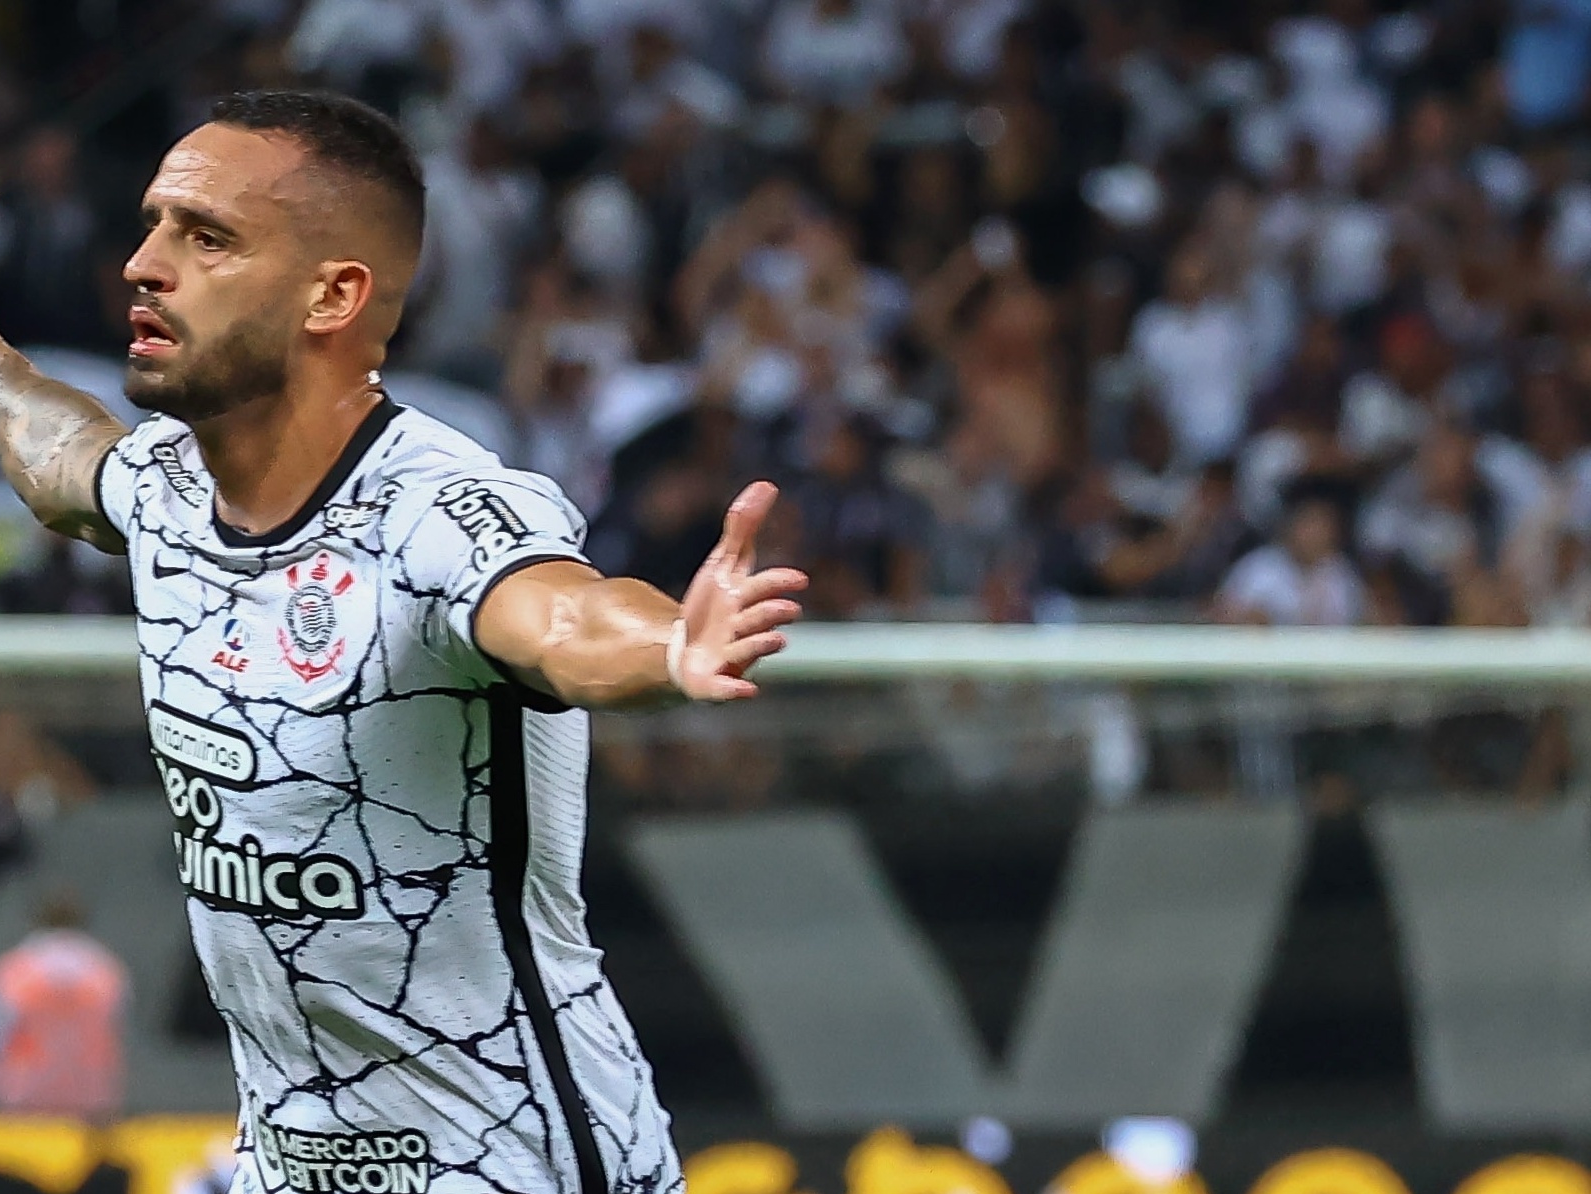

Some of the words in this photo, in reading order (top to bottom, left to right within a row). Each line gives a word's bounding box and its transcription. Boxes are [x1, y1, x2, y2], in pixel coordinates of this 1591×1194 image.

[211, 651, 250, 673] ALE
[172, 827, 358, 911] uímica
[276, 1130, 428, 1161] MERCADO
